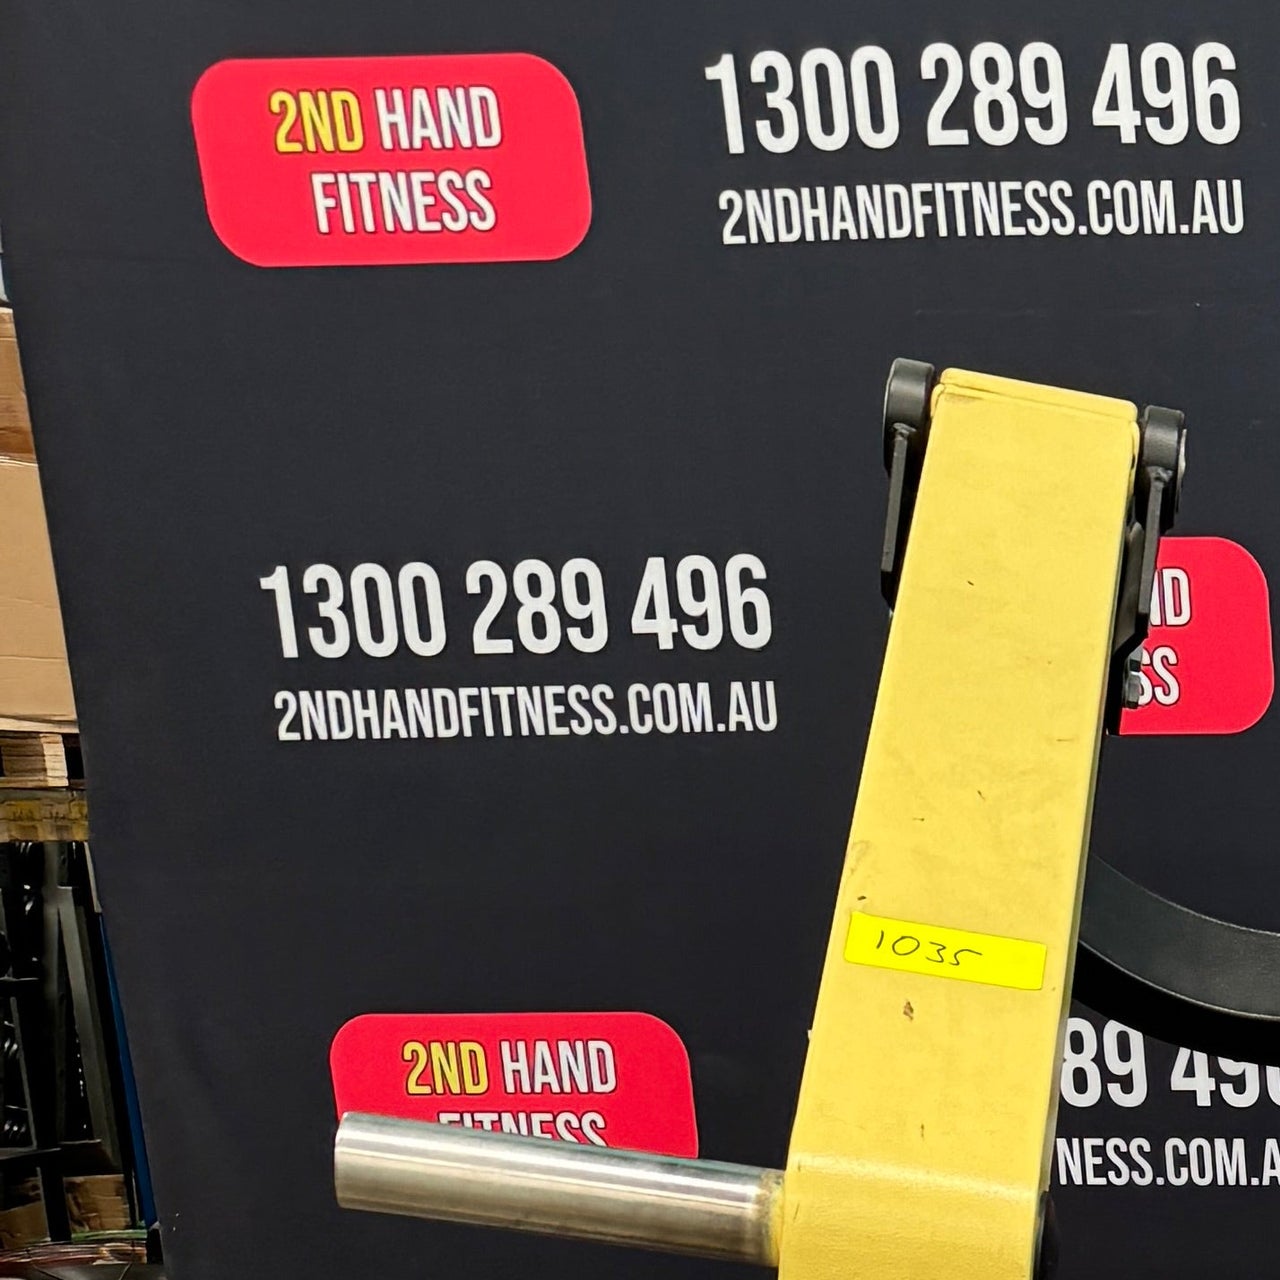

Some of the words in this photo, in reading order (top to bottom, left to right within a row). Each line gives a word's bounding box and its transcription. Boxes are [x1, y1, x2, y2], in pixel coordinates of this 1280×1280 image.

[270, 91, 363, 152] 2ND
[375, 87, 501, 149] HAND
[705, 45, 899, 154] 1300
[920, 42, 1067, 146] 289
[1092, 42, 1240, 145] 496
[312, 170, 495, 232] FITNESS
[719, 179, 1244, 244] 2NDHANDFITNESS.COM.AU
[260, 562, 446, 658] 1300
[466, 558, 608, 654] 289
[631, 554, 771, 650] 496
[274, 681, 777, 740] 2NDHANDFITNESS.COM.AU
[875, 930, 983, 966] 1035
[404, 1042, 488, 1093] 2ND
[501, 1041, 616, 1093] HAND
